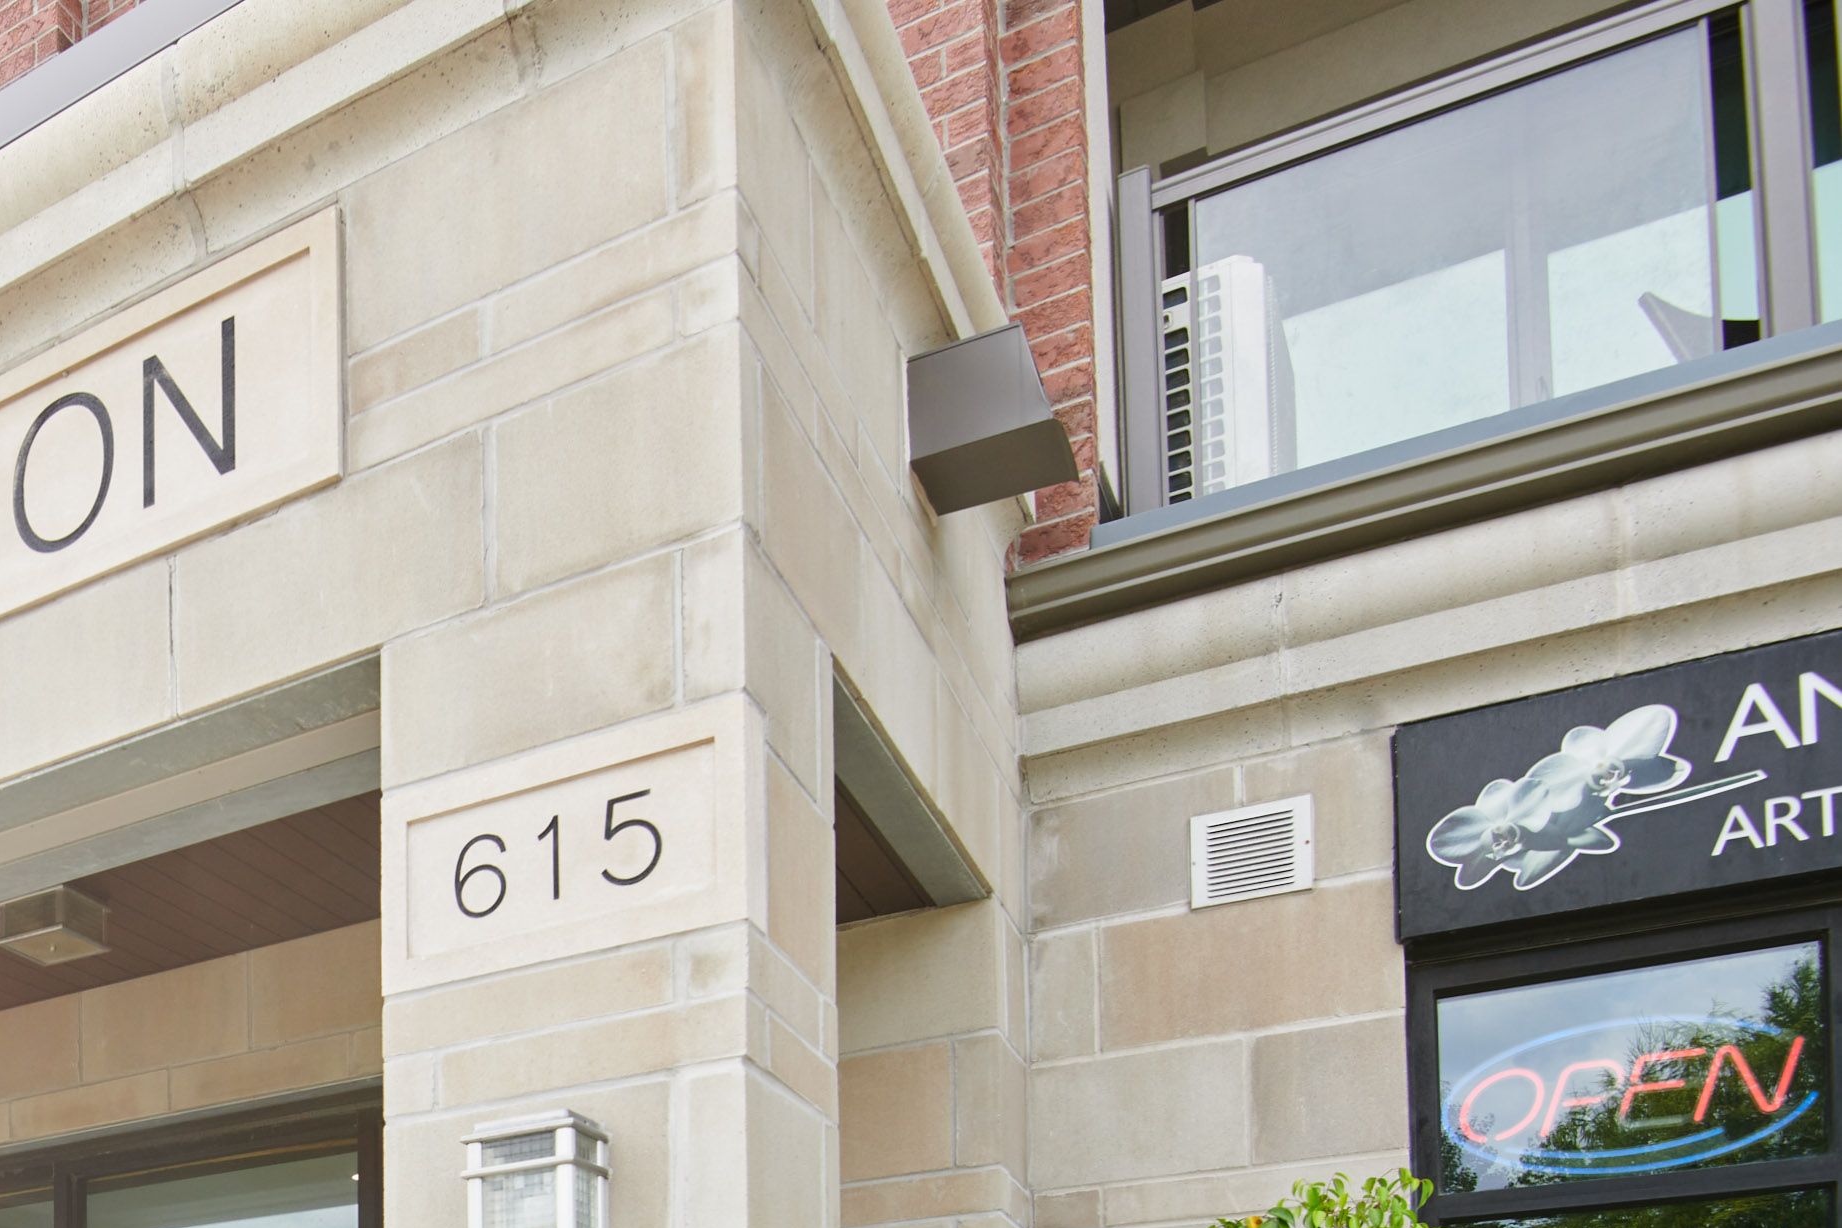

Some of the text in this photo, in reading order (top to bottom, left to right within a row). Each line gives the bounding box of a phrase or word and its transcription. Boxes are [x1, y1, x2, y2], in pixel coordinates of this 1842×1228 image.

[454, 789, 662, 919] 615
[1711, 786, 1842, 856] ART
[1459, 1036, 1805, 1142] OPEN
